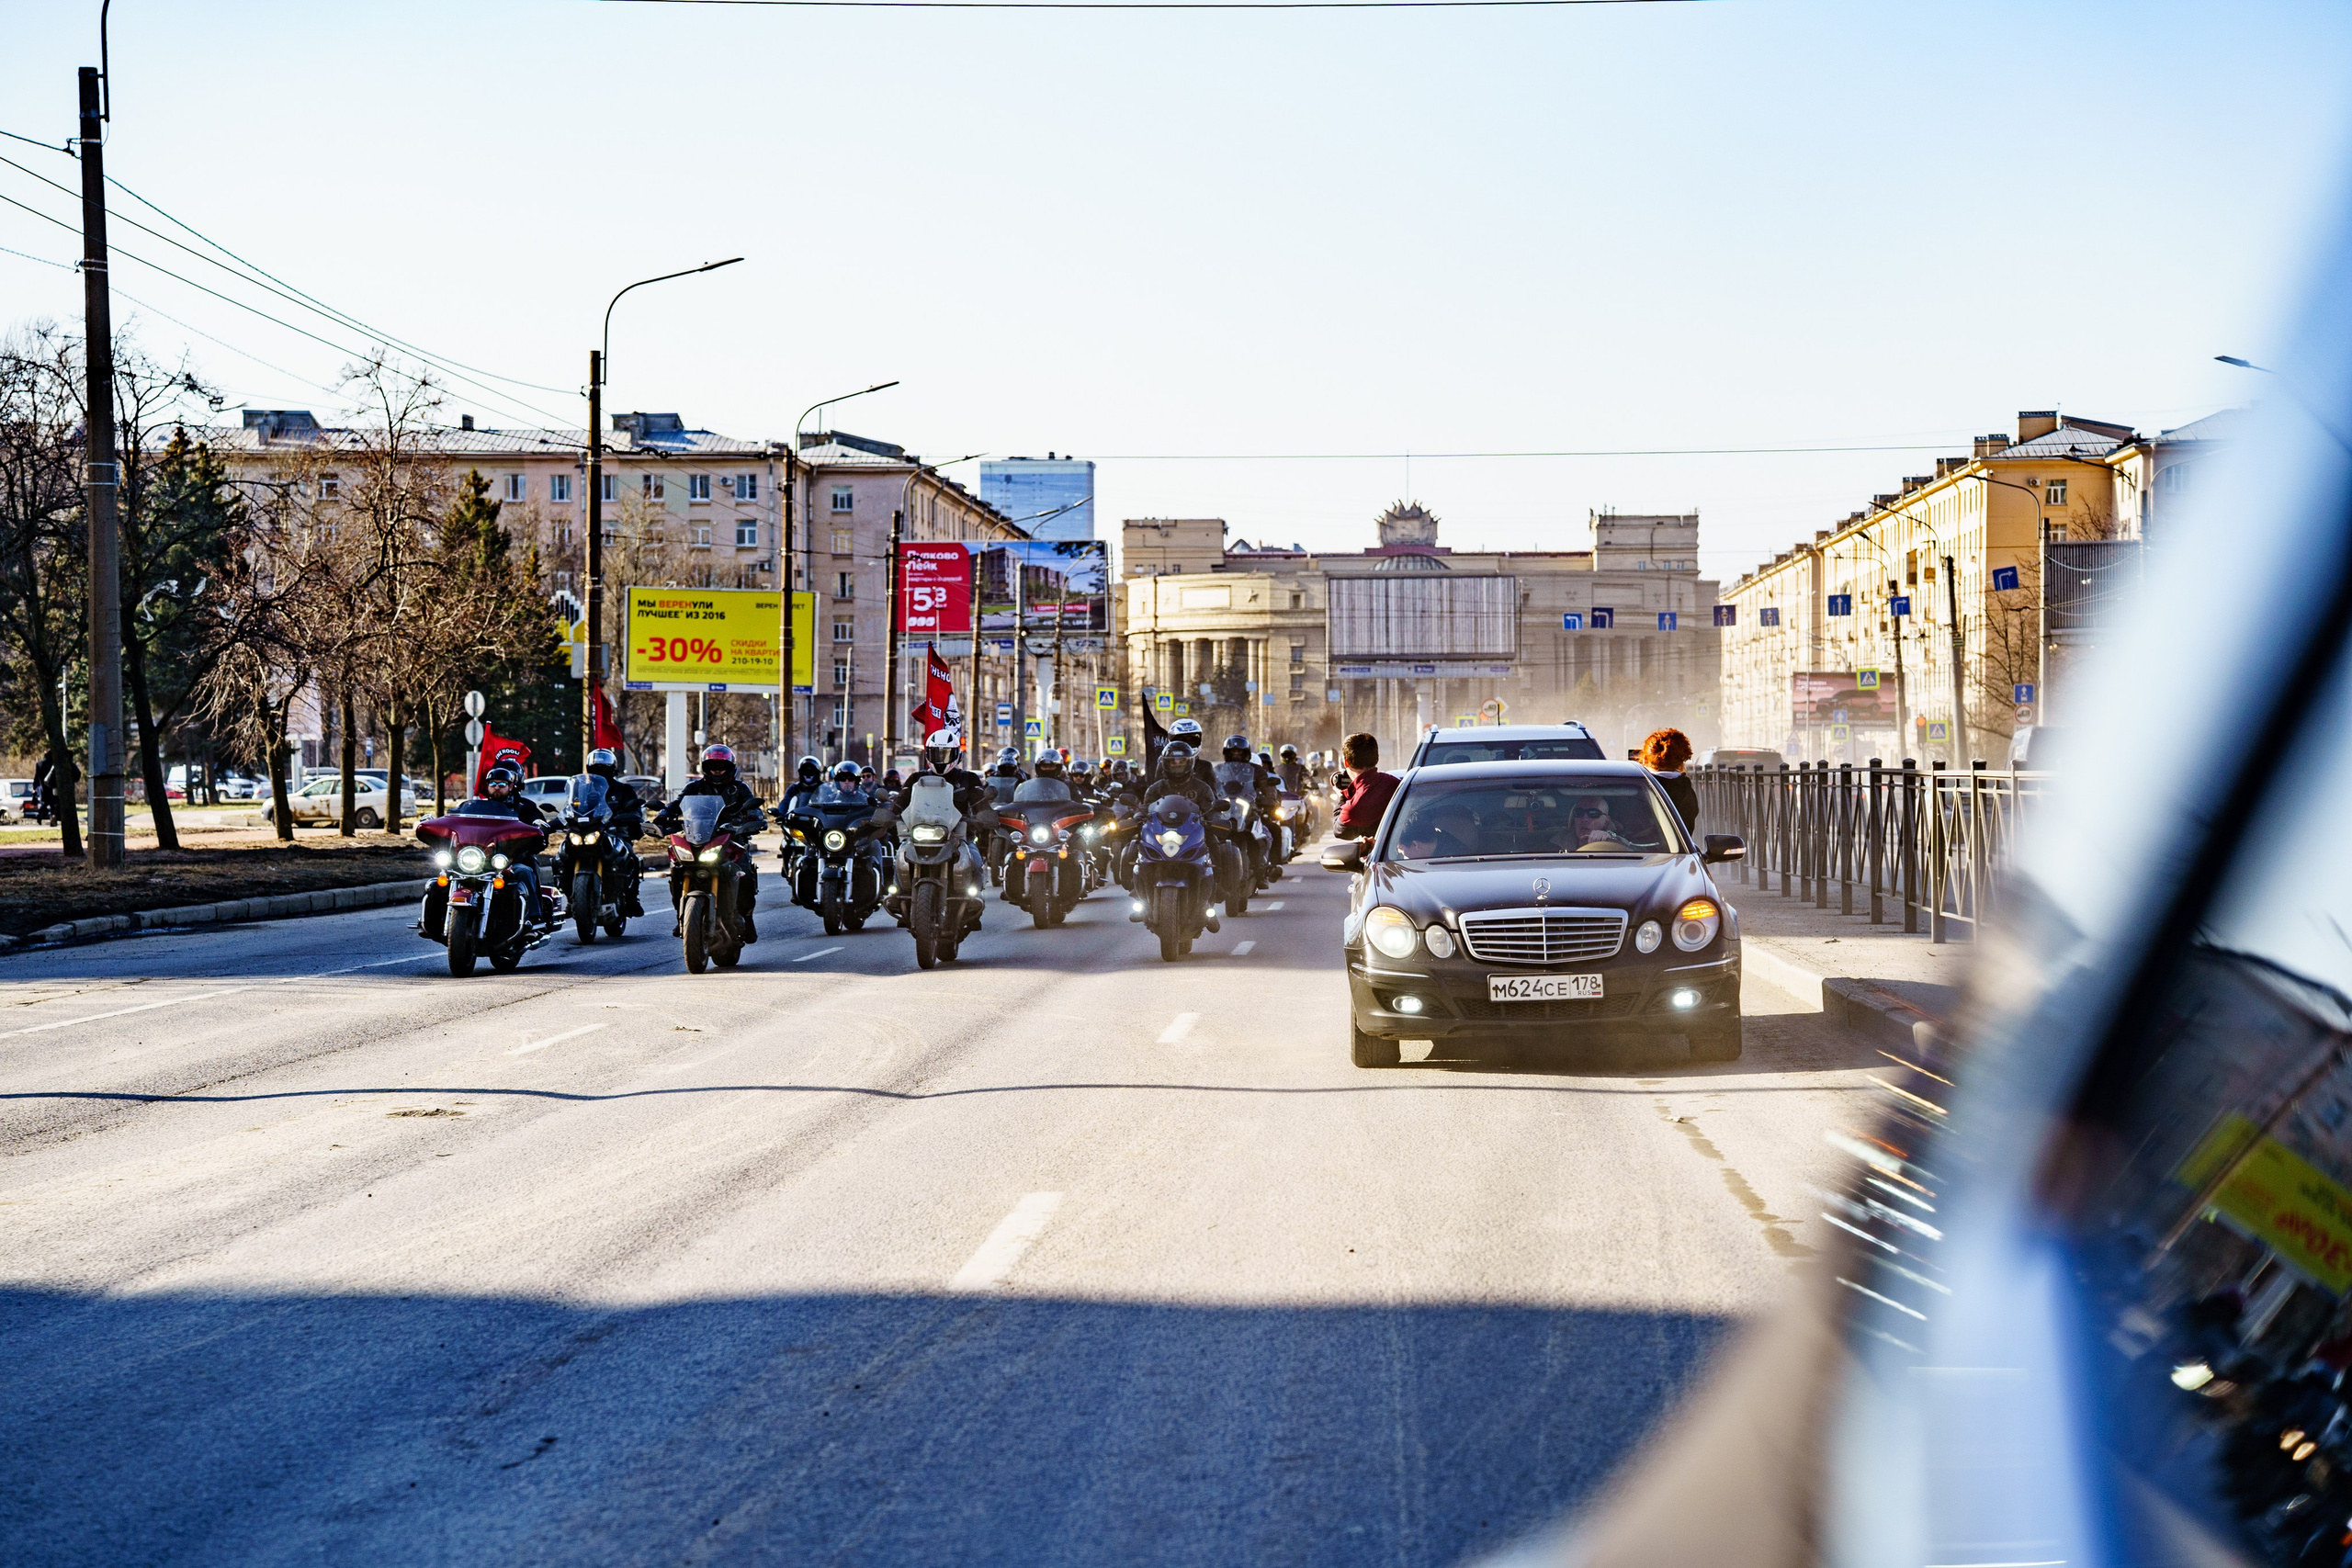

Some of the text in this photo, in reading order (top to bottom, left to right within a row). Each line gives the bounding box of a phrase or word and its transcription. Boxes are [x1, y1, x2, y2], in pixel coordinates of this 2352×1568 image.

[638, 599, 713, 610] МЫ ВЕРЕНУЛИ
[685, 611, 699, 619] ИЗ
[702, 612, 726, 620] 2016
[730, 639, 767, 648] СКИДКИ
[637, 637, 722, 664] -30%
[745, 649, 781, 657] КВАРТИ
[731, 657, 774, 665] 210-19-10
[1571, 976, 1599, 991] 178
